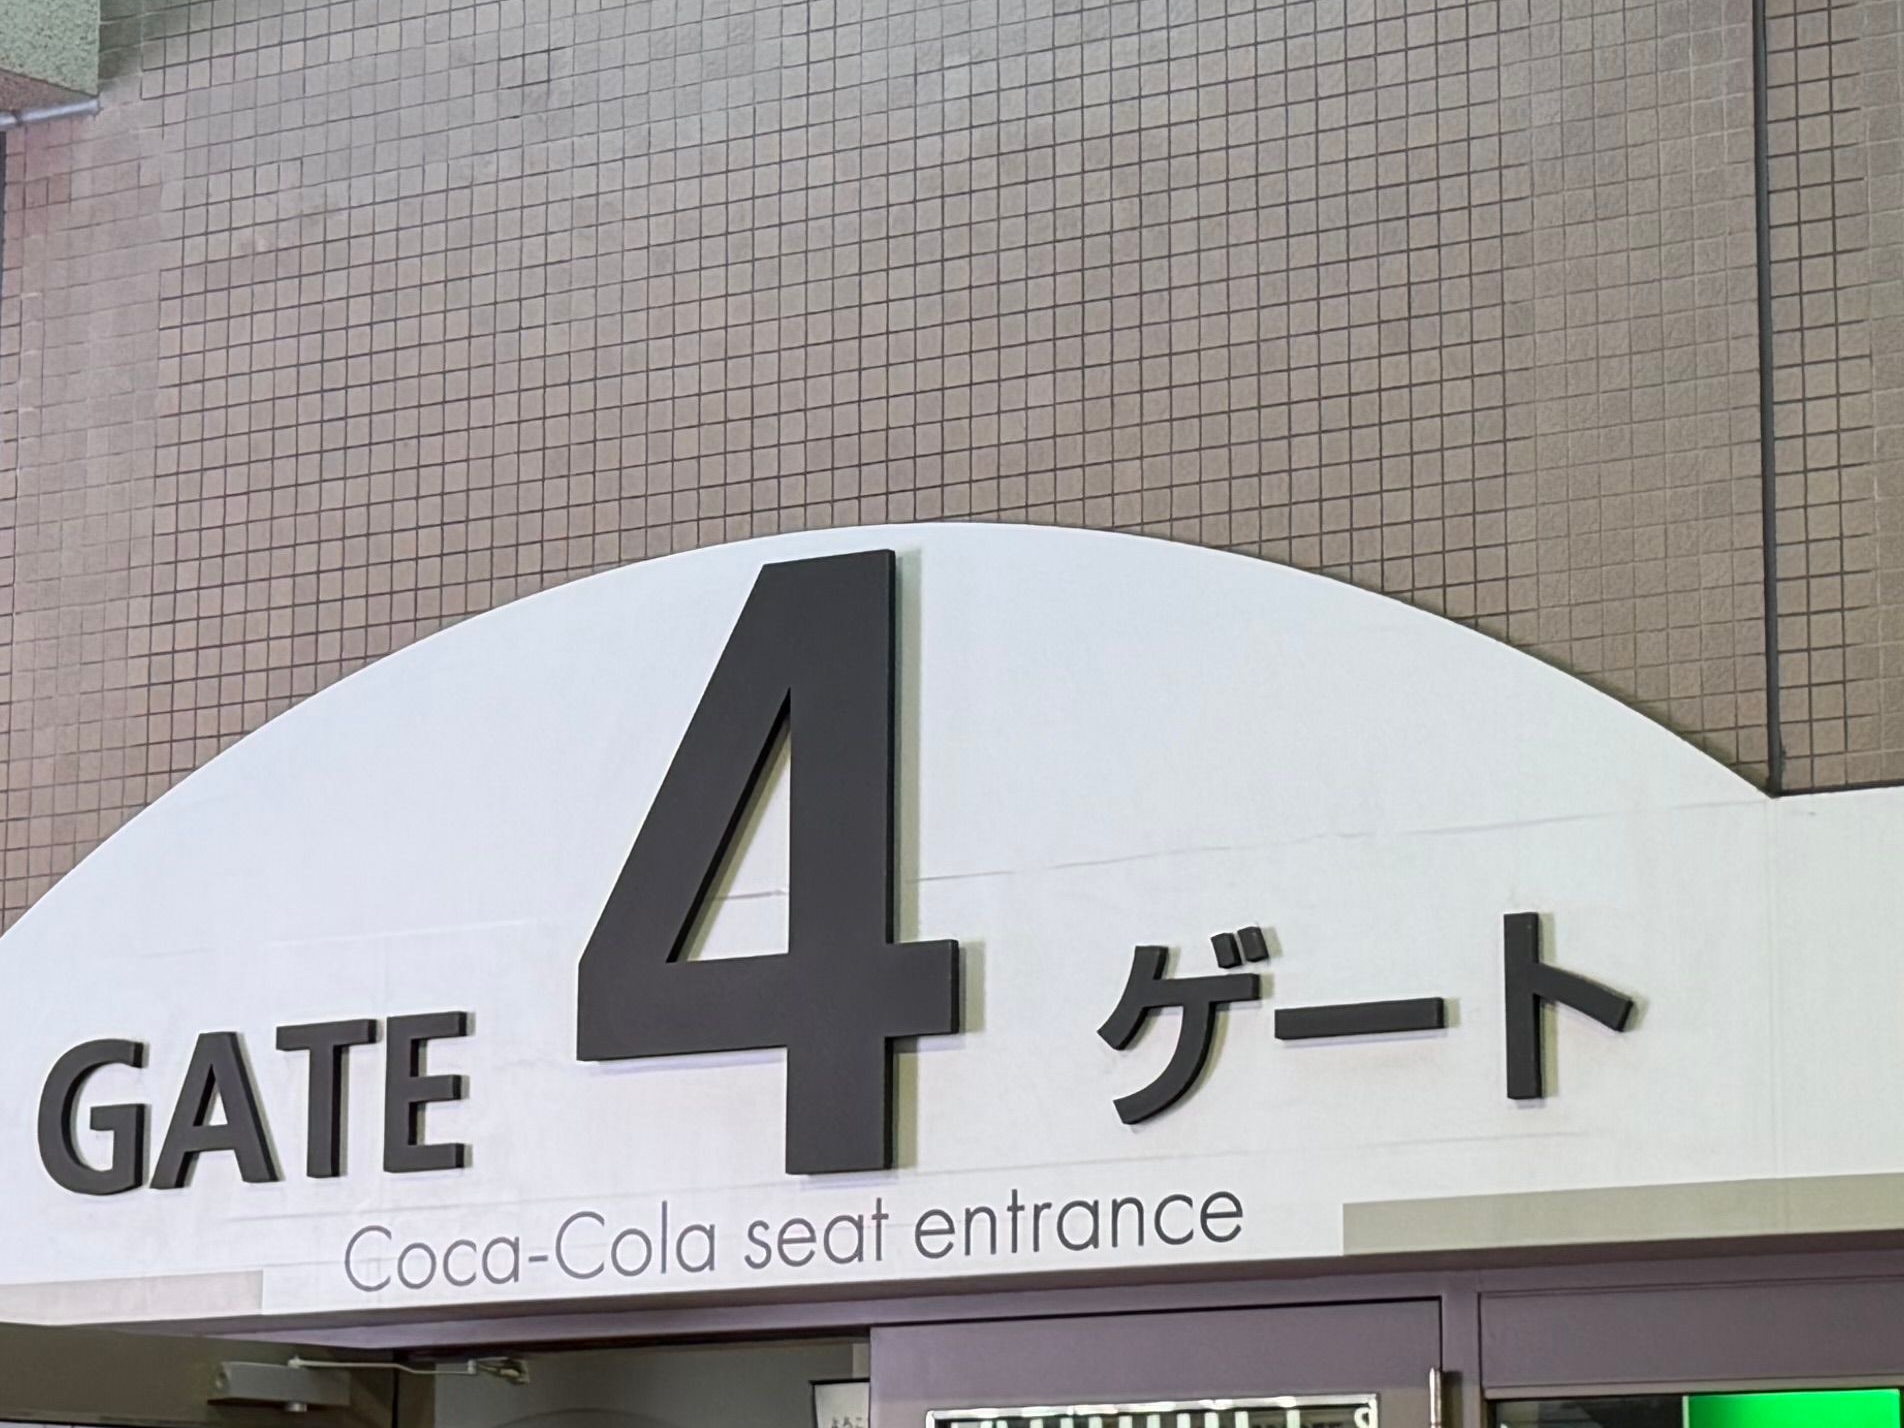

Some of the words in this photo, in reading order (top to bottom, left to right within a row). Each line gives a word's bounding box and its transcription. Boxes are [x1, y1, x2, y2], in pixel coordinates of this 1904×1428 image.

[37, 1010, 472, 1197] GATE
[576, 547, 962, 1176] 4
[1096, 911, 1638, 1126] ゲート
[343, 1198, 718, 1296] Coca-Cola
[742, 1203, 889, 1272] seat
[913, 1185, 1246, 1261] entrance
